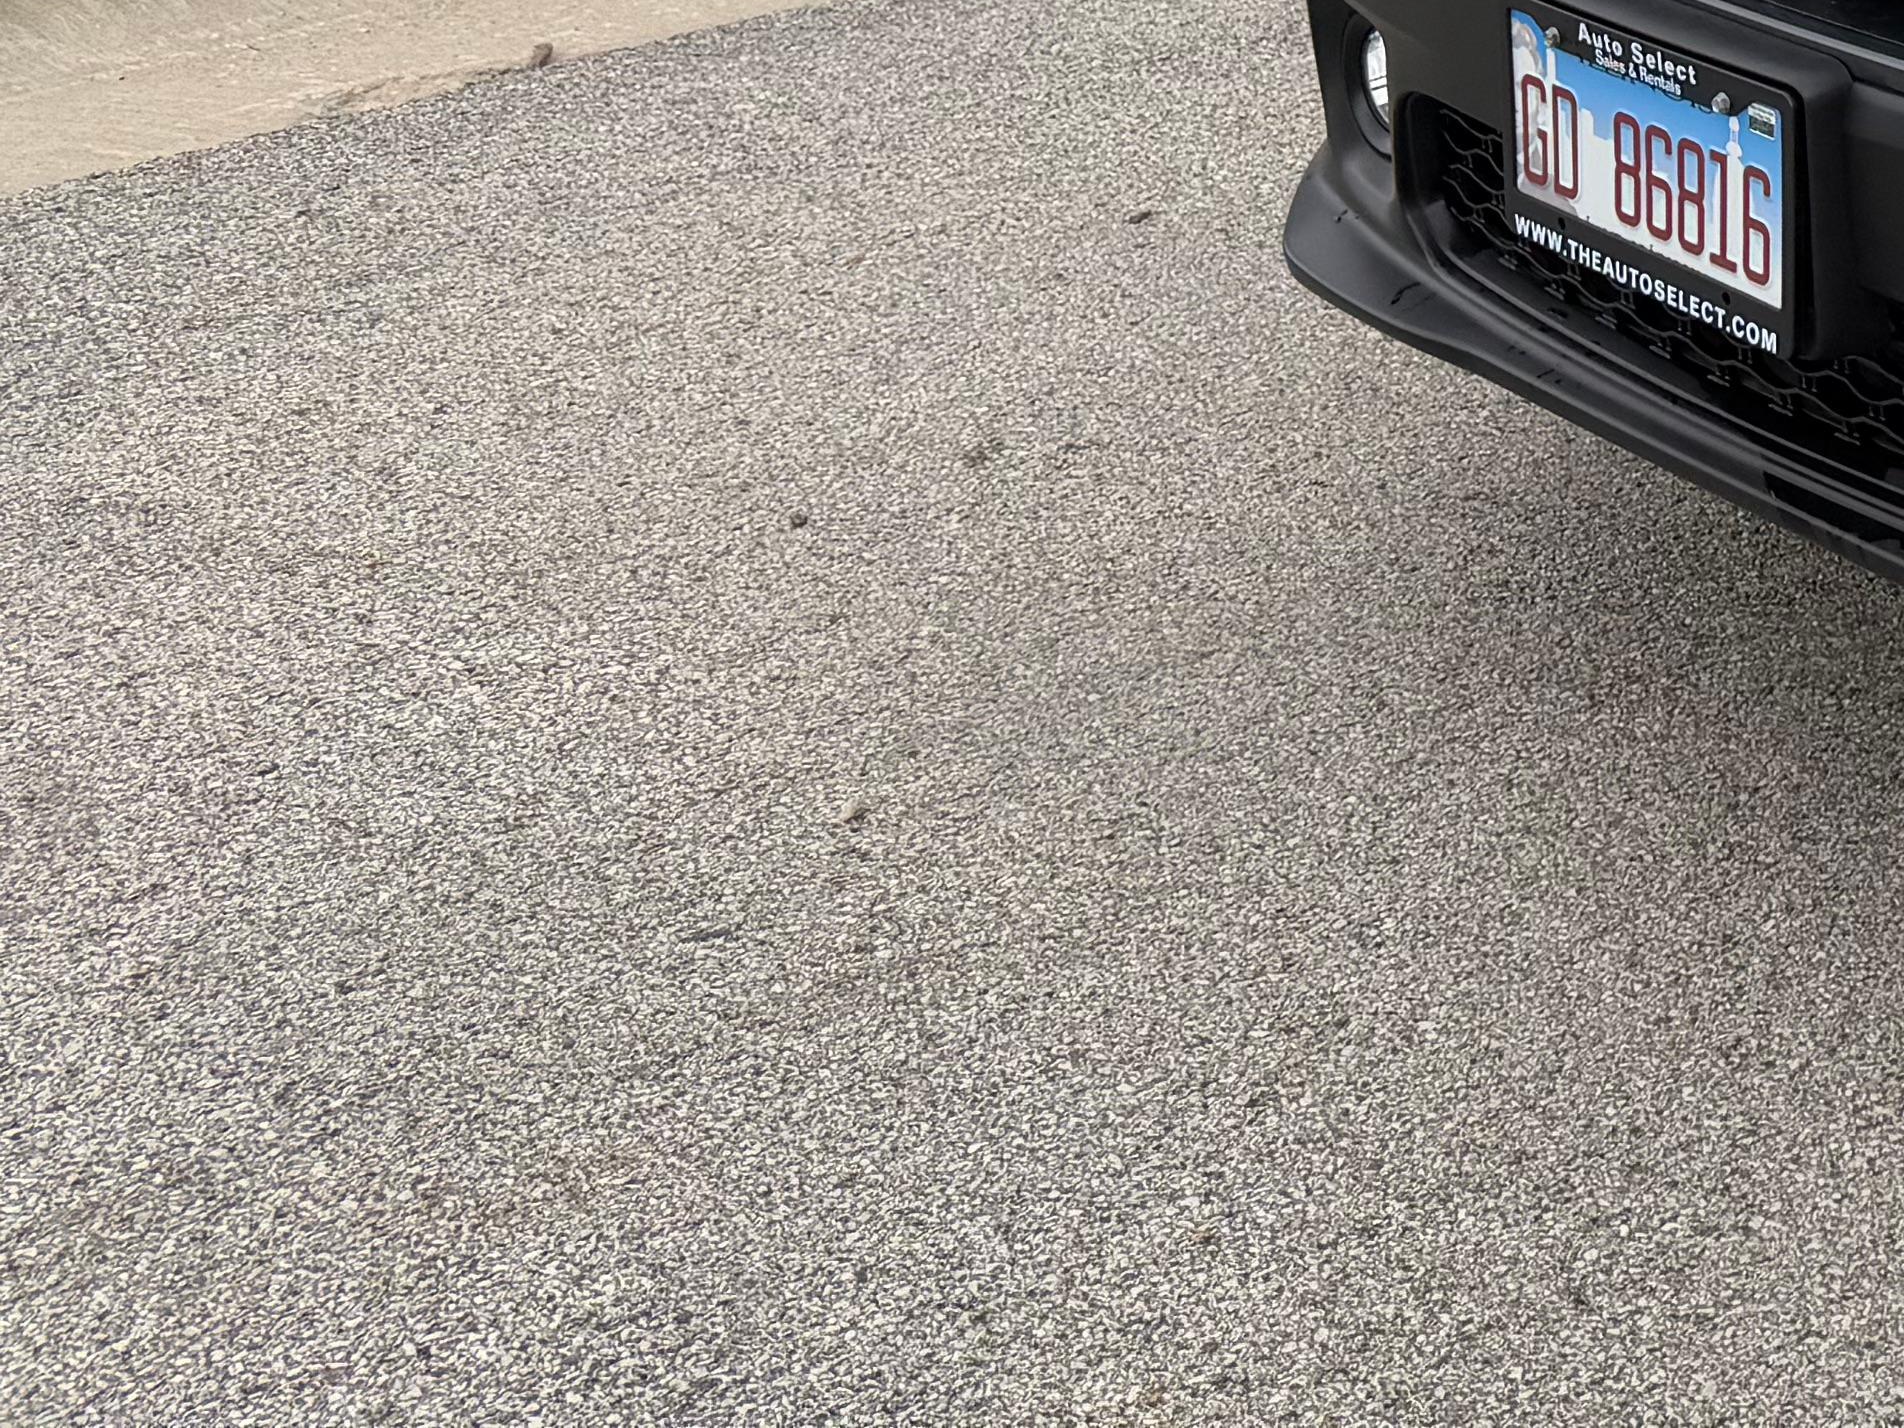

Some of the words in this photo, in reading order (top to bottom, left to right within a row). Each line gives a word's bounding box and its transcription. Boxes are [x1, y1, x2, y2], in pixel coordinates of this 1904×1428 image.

[1578, 22, 1623, 57] Auto
[1630, 42, 1697, 85] Select
[1595, 48, 1627, 75] Sales
[1628, 62, 1638, 79] &
[1639, 65, 1682, 96] Rentals
[1521, 72, 1580, 200] GD
[1613, 110, 1773, 287] 86816
[1514, 212, 1778, 354] WWW.THEAUTOSELECT.COM
